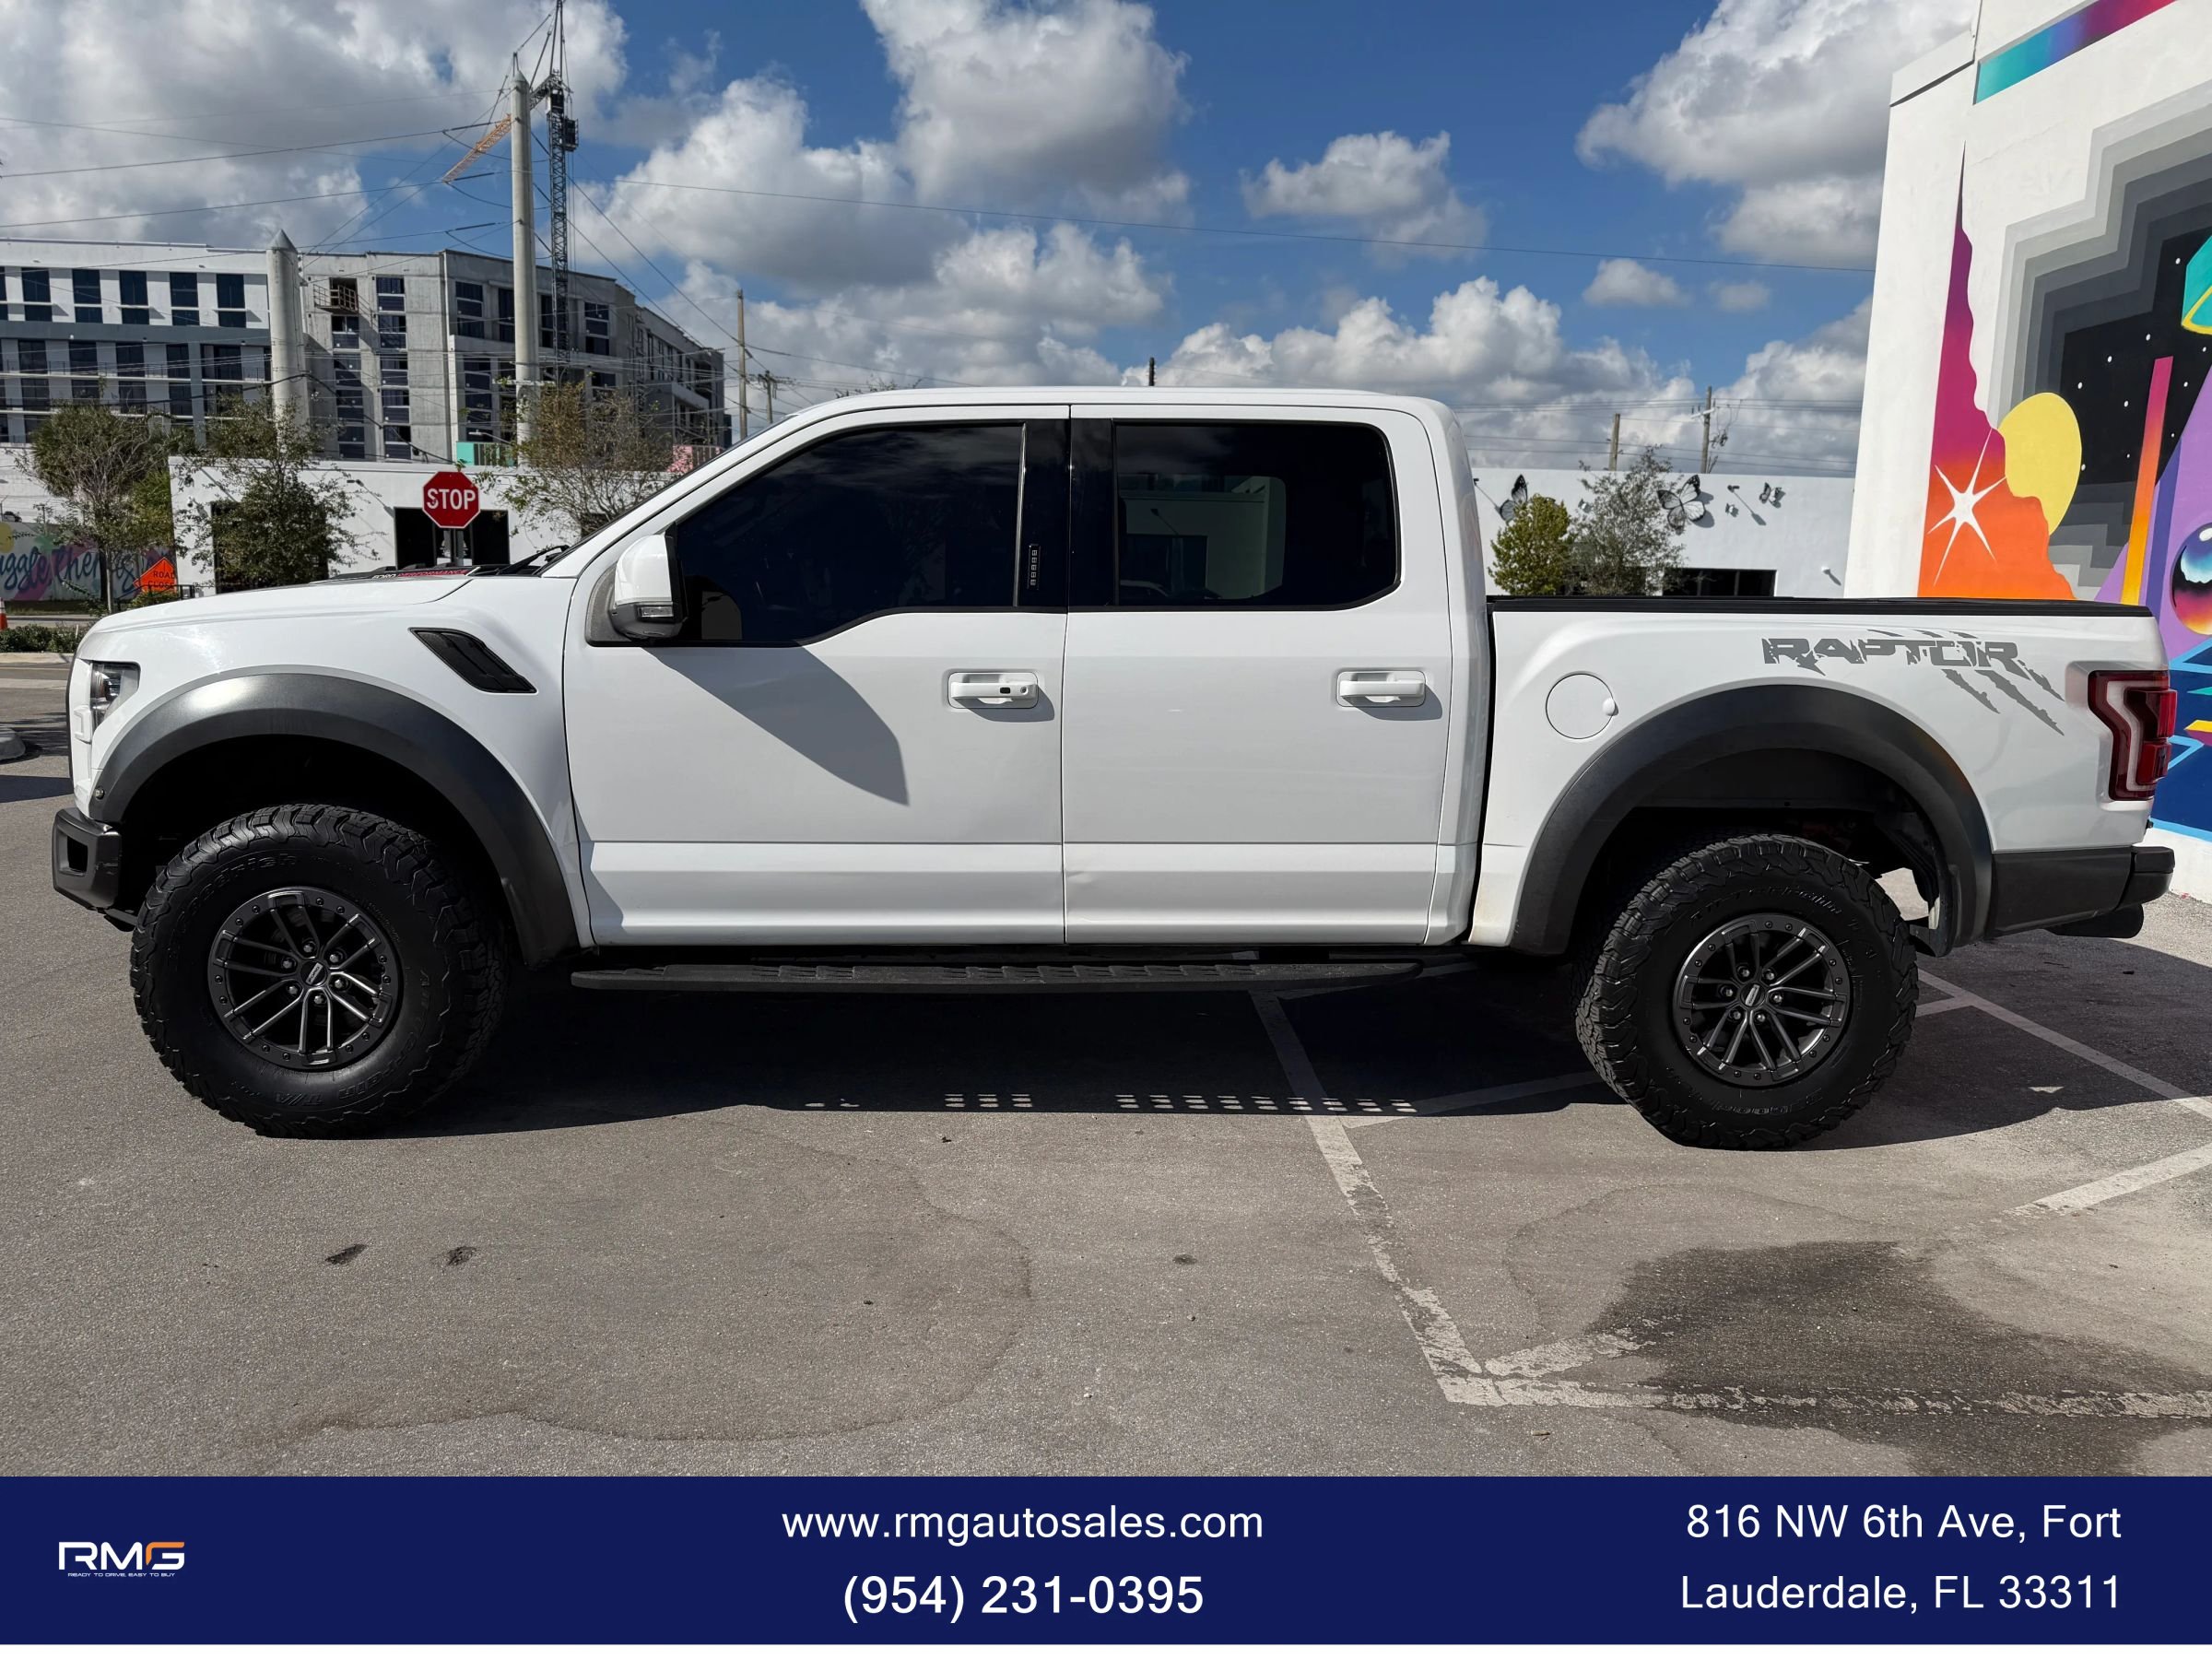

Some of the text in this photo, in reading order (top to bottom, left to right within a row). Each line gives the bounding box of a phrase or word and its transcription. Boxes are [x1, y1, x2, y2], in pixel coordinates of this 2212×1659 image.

[427, 488, 477, 511] STOP
[153, 570, 174, 579] ROAD
[147, 580, 174, 589] CLOSE
[1760, 638, 2032, 680] RAPTOR
